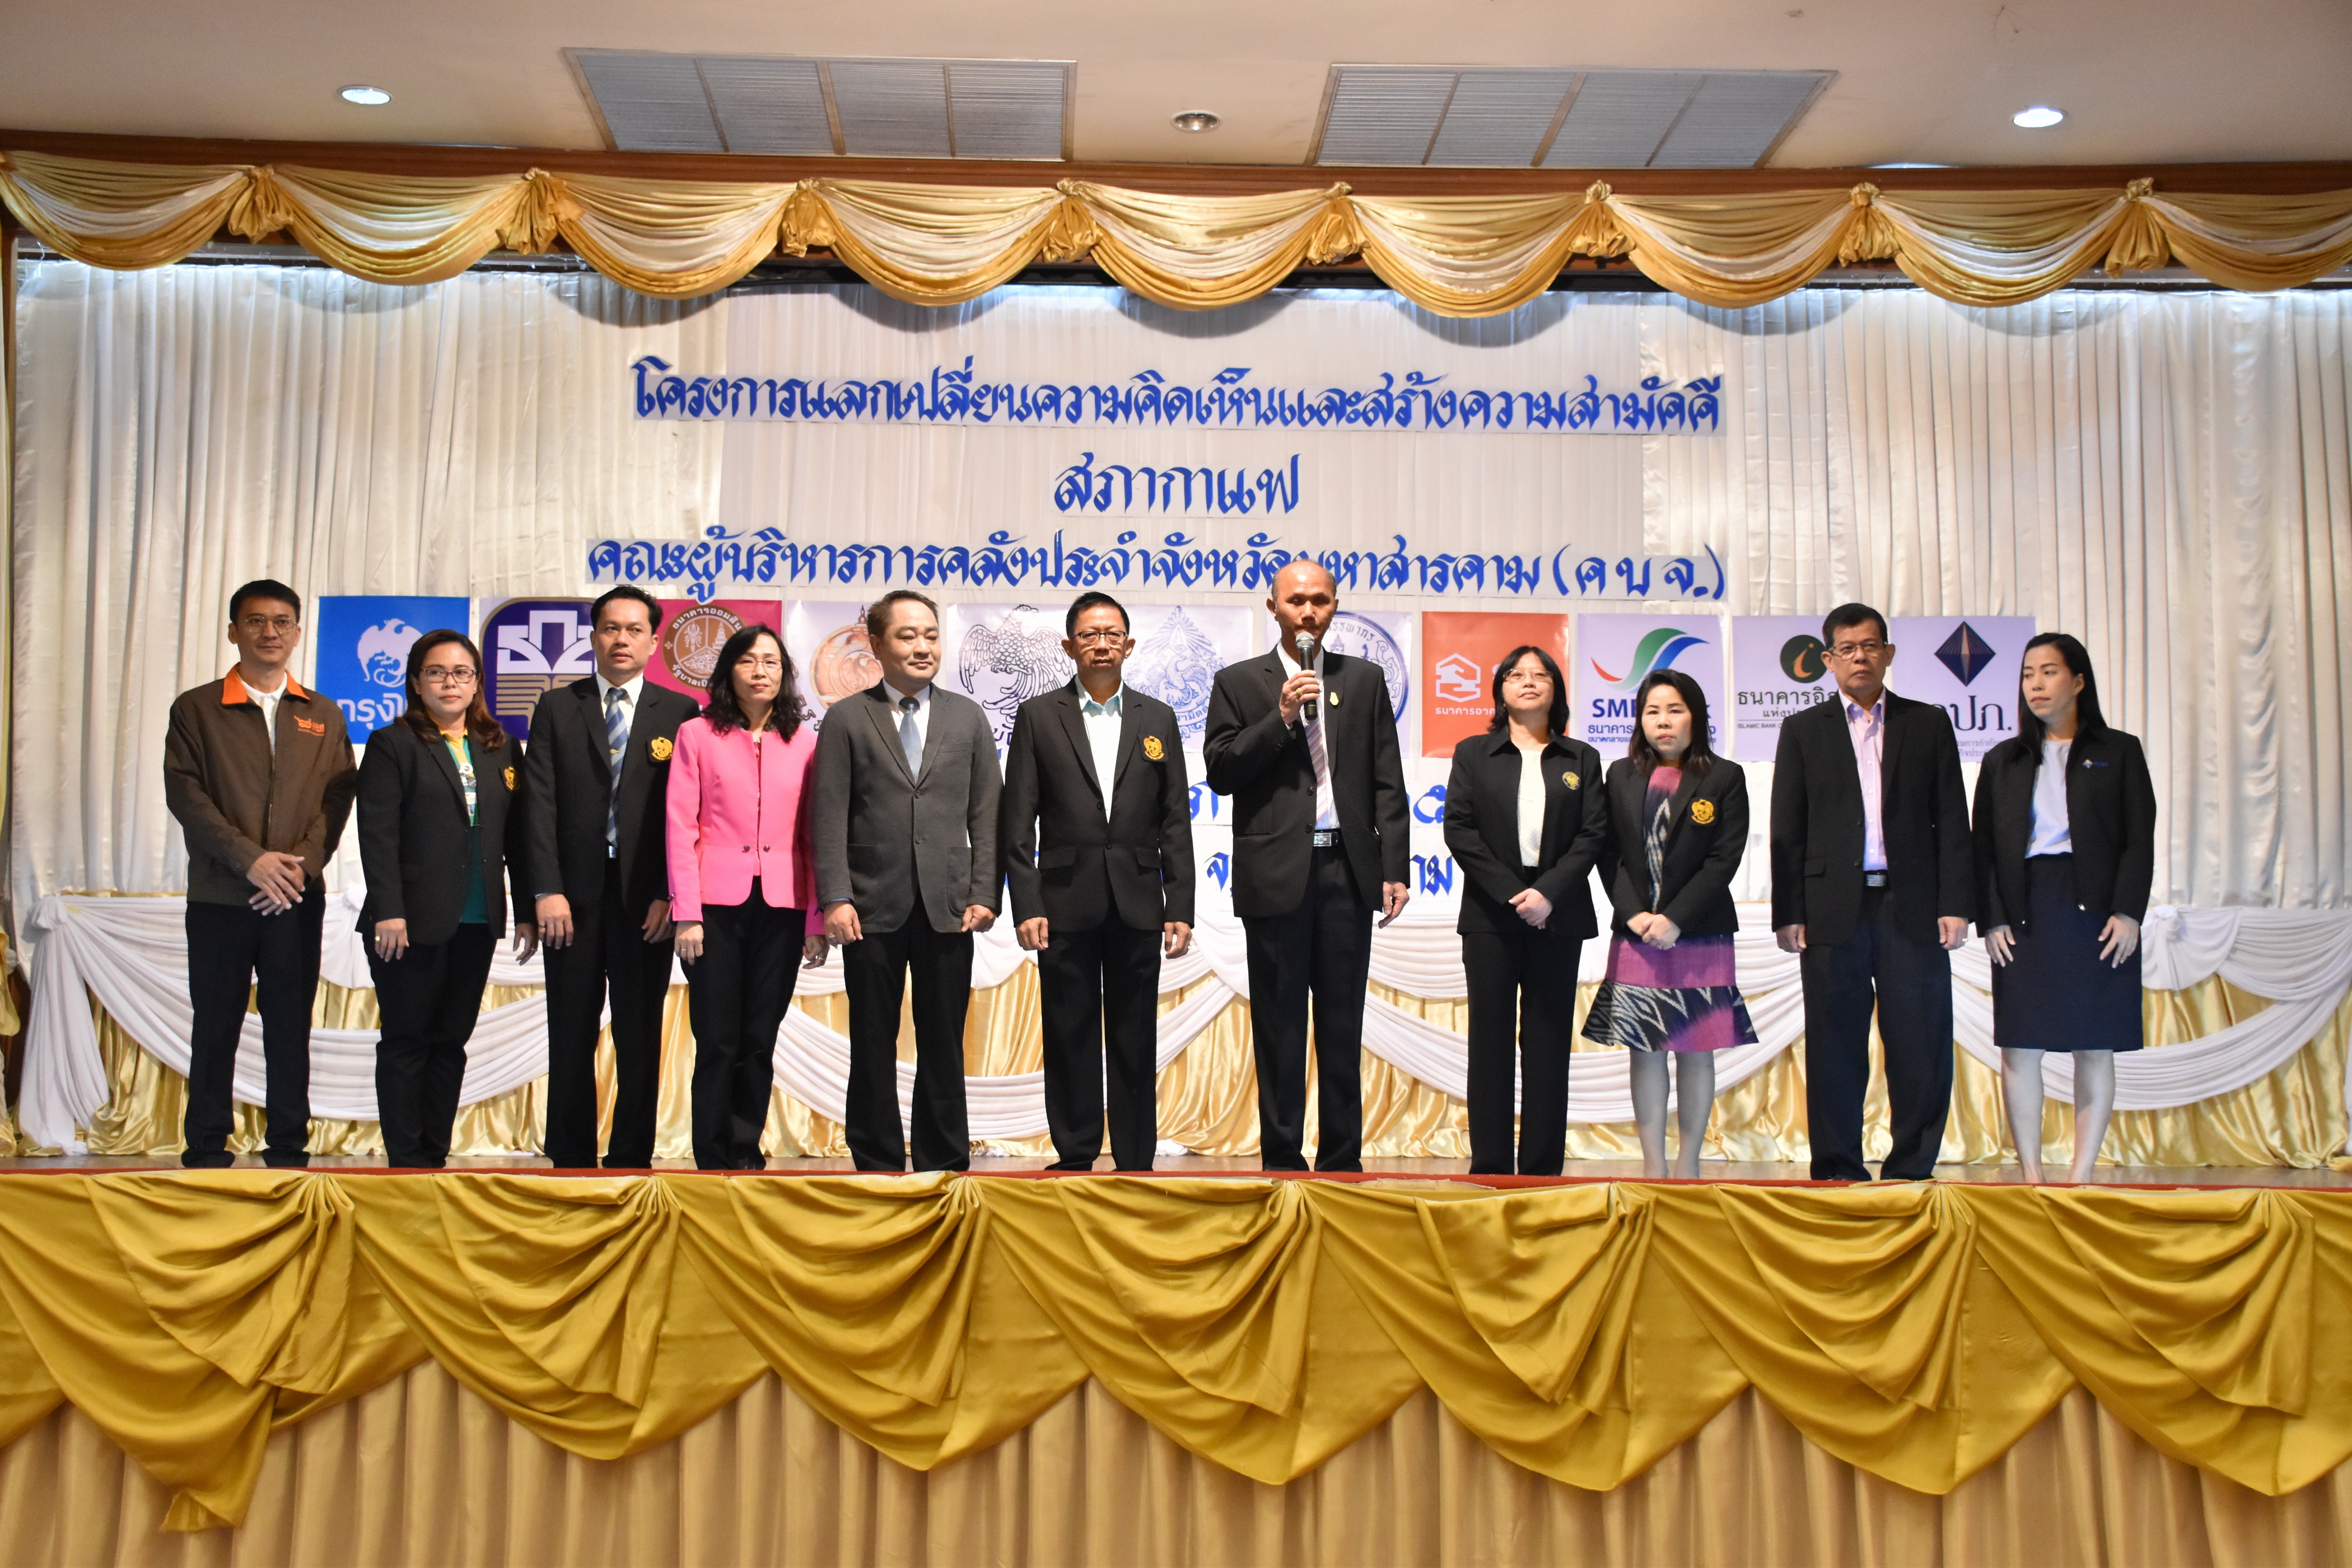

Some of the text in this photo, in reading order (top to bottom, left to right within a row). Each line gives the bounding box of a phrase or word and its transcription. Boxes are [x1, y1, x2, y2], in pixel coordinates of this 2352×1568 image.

[1054, 452, 1299, 514] สภากาแฟ
[1328, 621, 1375, 641] รรพากร
[337, 693, 408, 730] กรุงไ
[1932, 695, 2013, 731] ปภ.
